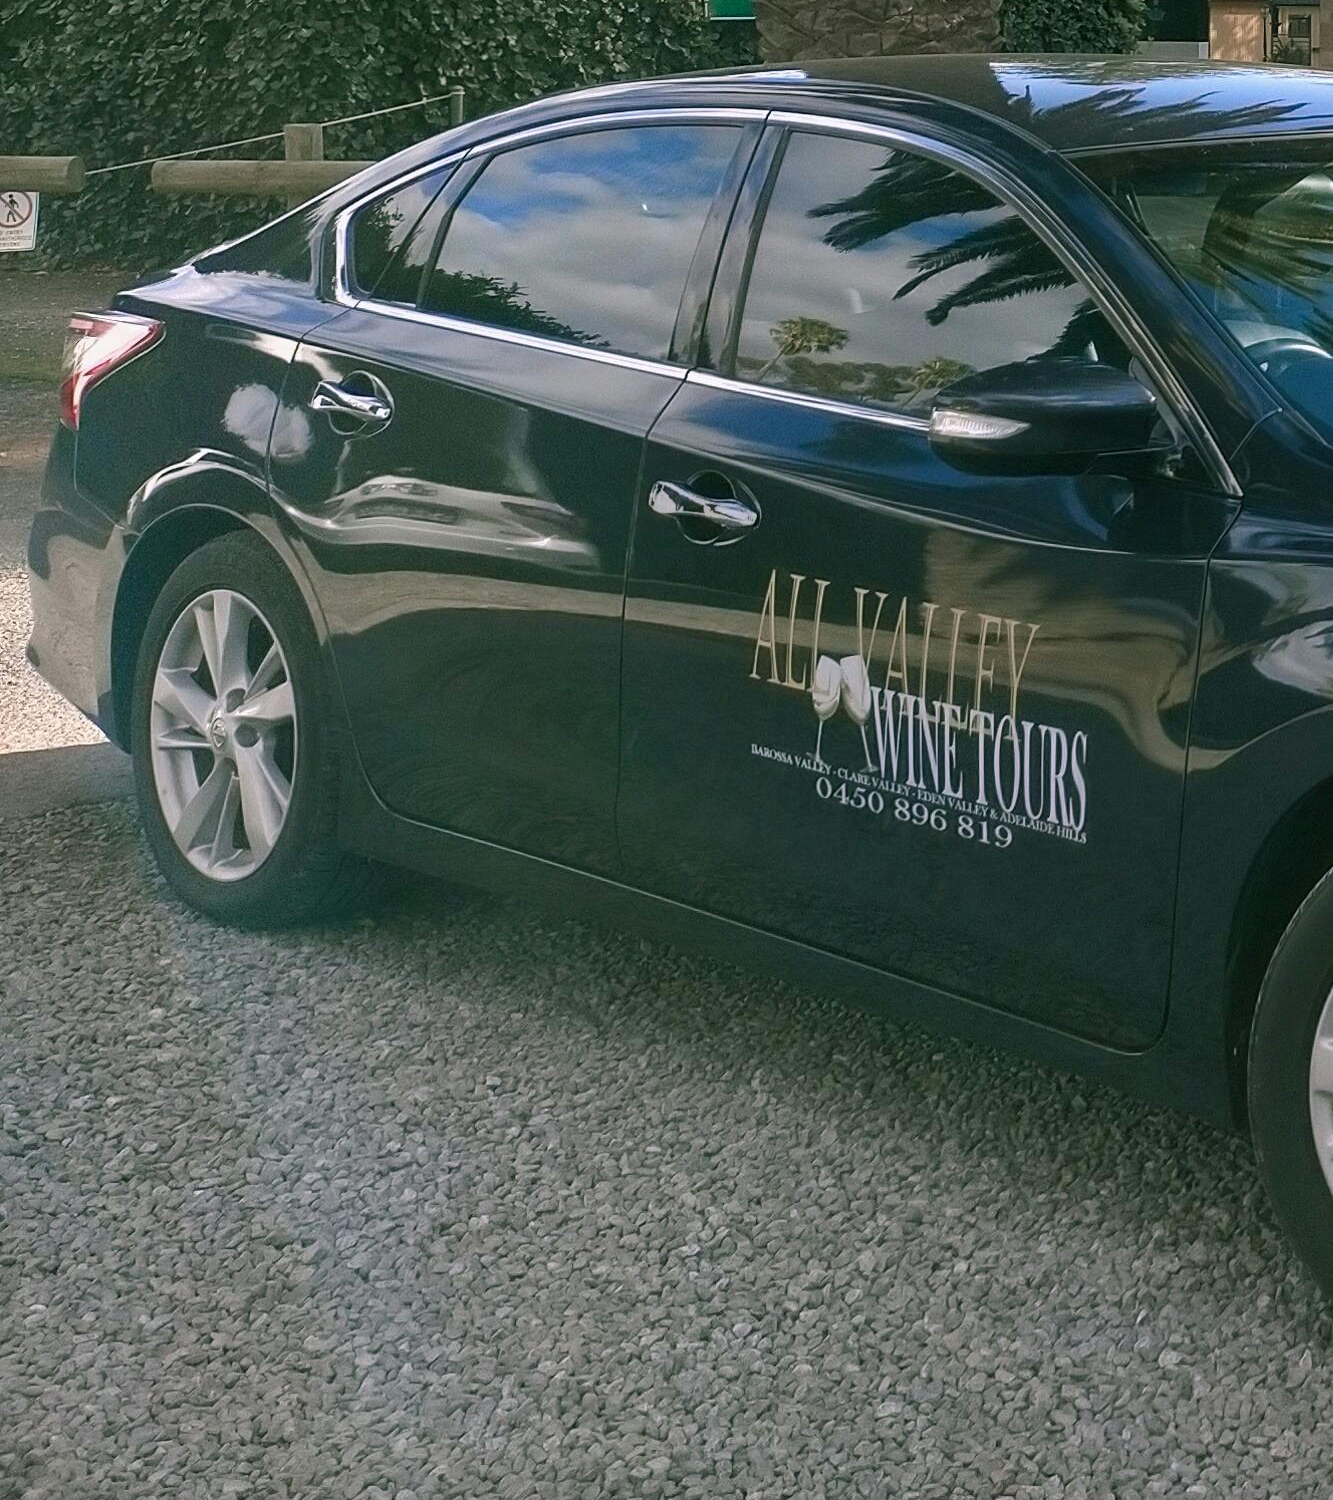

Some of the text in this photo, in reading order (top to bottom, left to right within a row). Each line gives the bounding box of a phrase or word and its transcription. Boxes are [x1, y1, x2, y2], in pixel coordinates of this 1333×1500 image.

[749, 569, 1041, 742] ALL VALLEY
[751, 743, 793, 765] BAROSSA
[794, 755, 832, 775] VALLEY
[837, 767, 871, 787] CLARE
[872, 778, 911, 797] VALLEY
[917, 789, 947, 807] EDEN
[949, 797, 989, 817] VALLEY
[999, 811, 1056, 835] ADELAIDE
[815, 776, 1014, 849] 0450 896 819
[871, 686, 1088, 832] WINE TOURS
